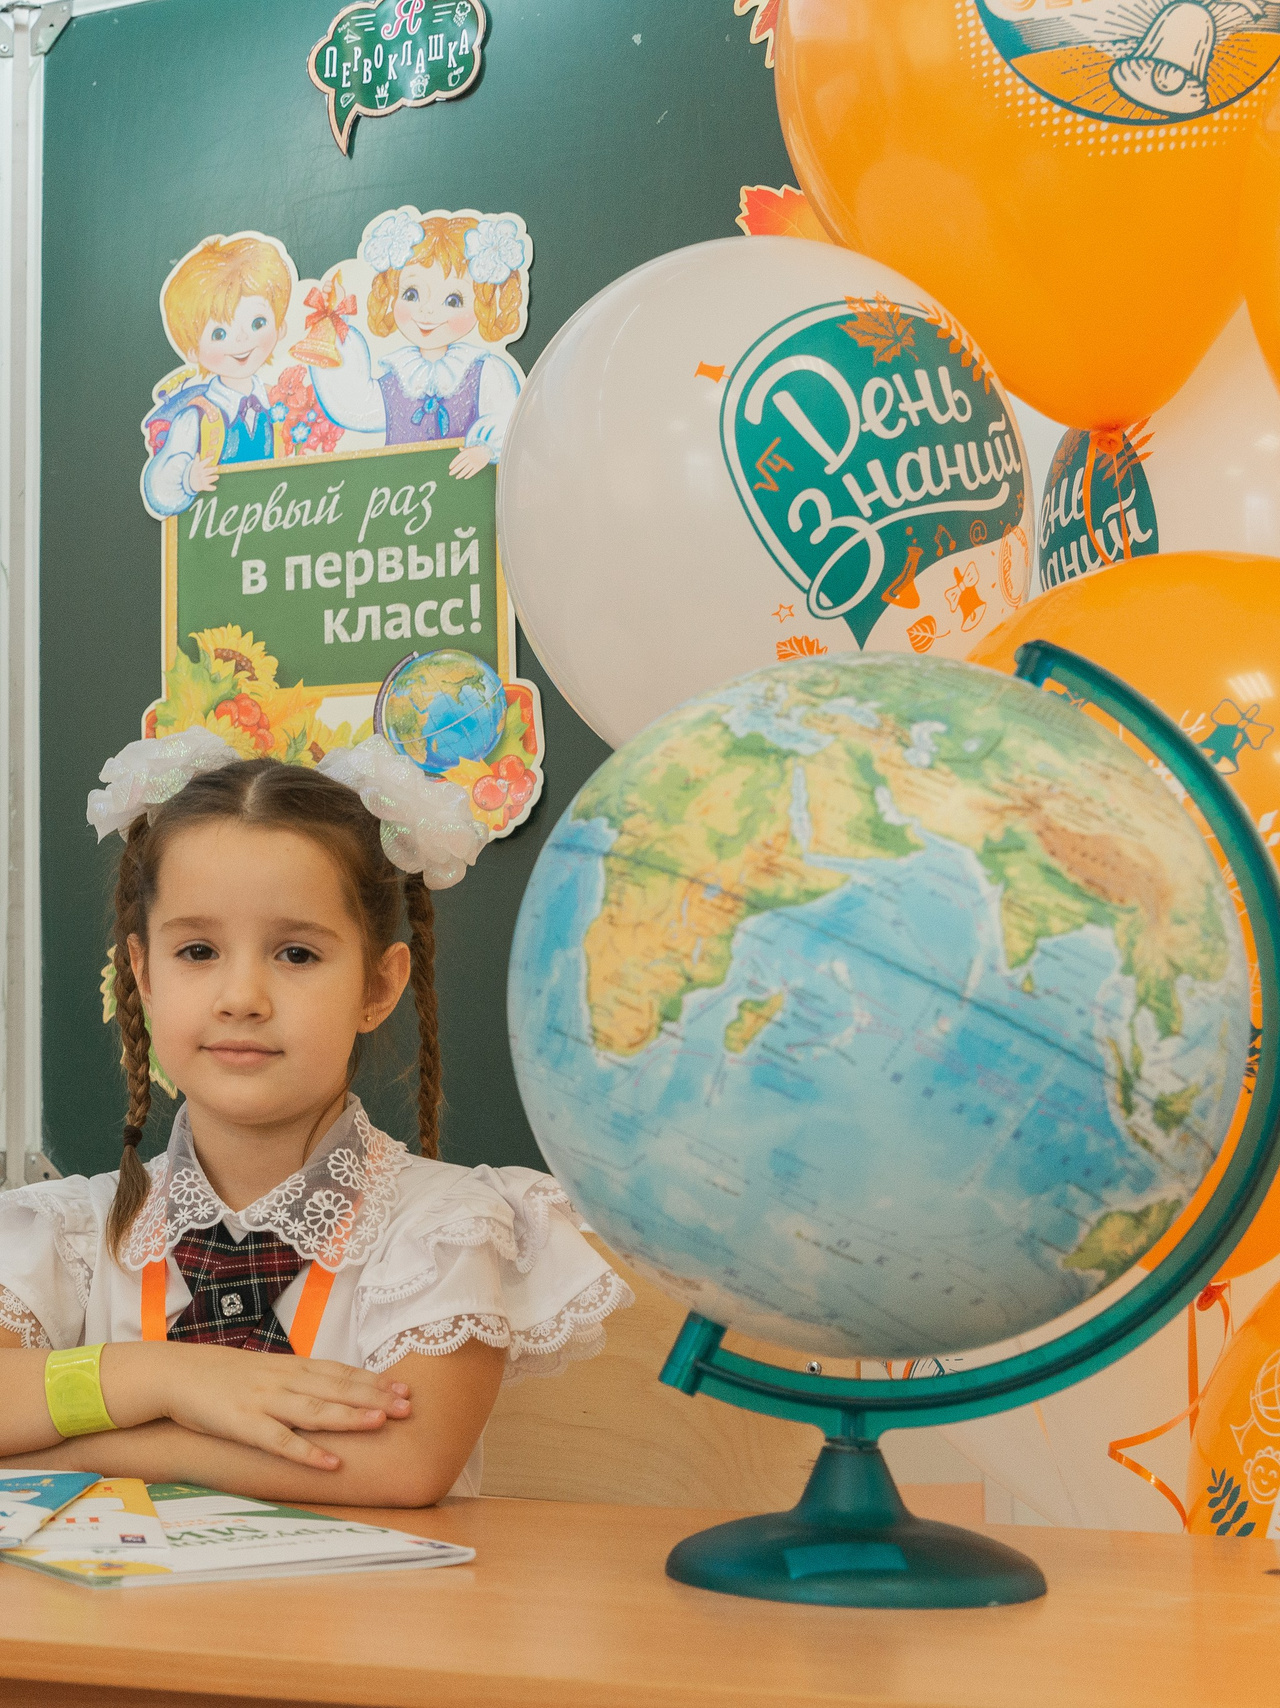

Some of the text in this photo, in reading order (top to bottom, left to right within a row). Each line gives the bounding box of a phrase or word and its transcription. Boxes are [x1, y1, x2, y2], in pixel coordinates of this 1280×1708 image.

[381, 0, 425, 41] Я
[324, 28, 470, 88] ПЕРВОКЛАШКА
[744, 353, 972, 475] День
[189, 478, 438, 555] Первый раз
[787, 412, 1022, 620] Знаний
[1040, 466, 1086, 550] ень
[241, 528, 481, 599] в первый
[323, 584, 483, 647] класс!
